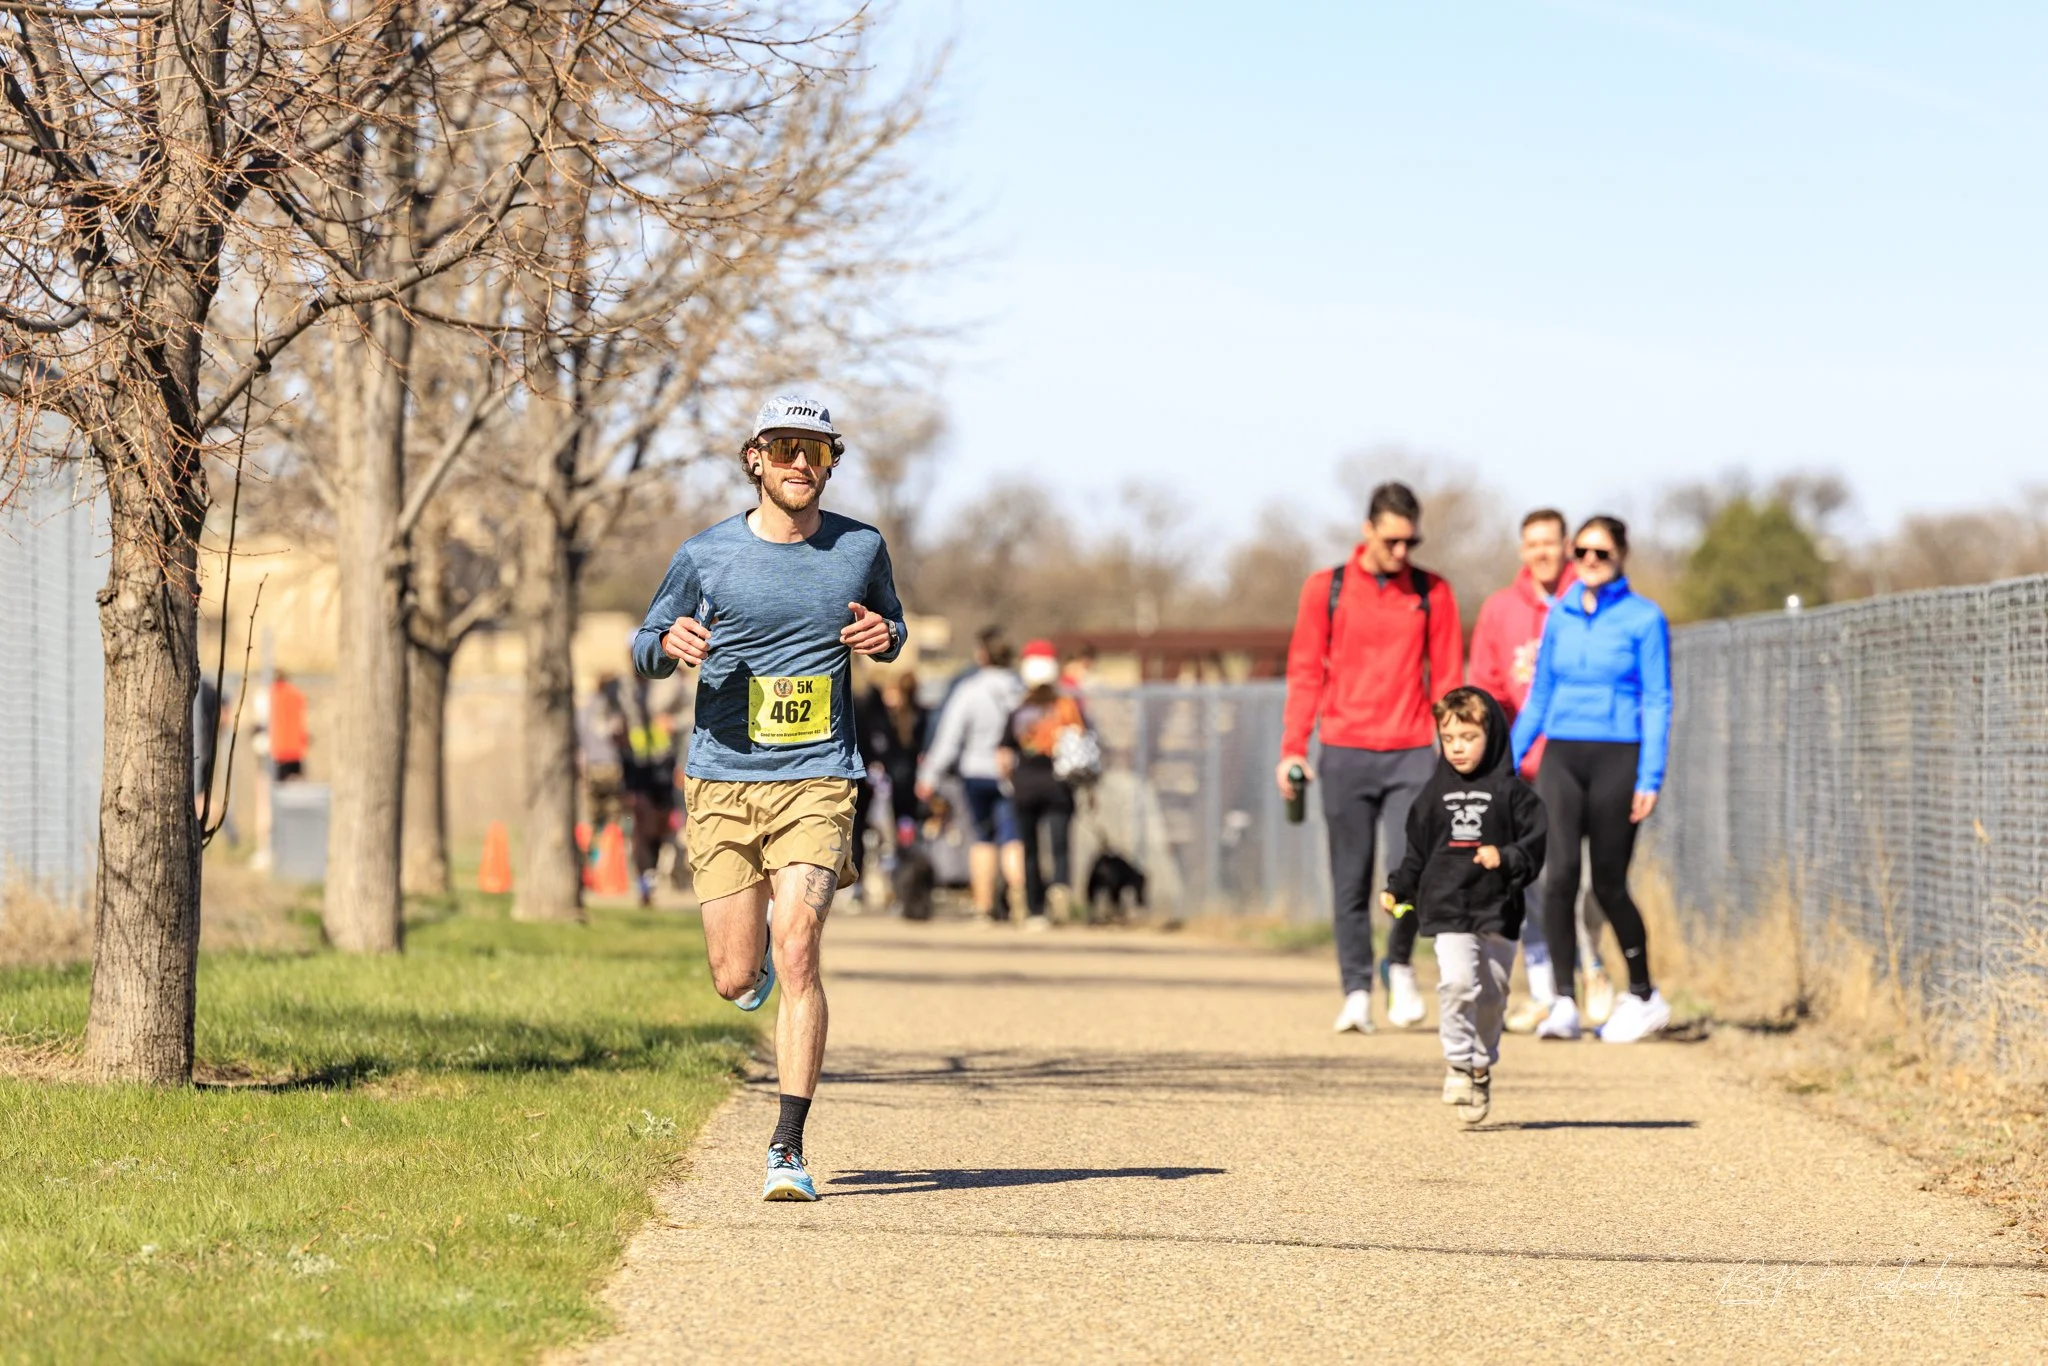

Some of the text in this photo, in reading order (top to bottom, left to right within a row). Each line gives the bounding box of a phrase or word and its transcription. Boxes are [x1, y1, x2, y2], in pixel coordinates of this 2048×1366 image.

[785, 406, 818, 417] rnnr
[797, 680, 813, 694] 5K
[770, 700, 812, 724] 462
